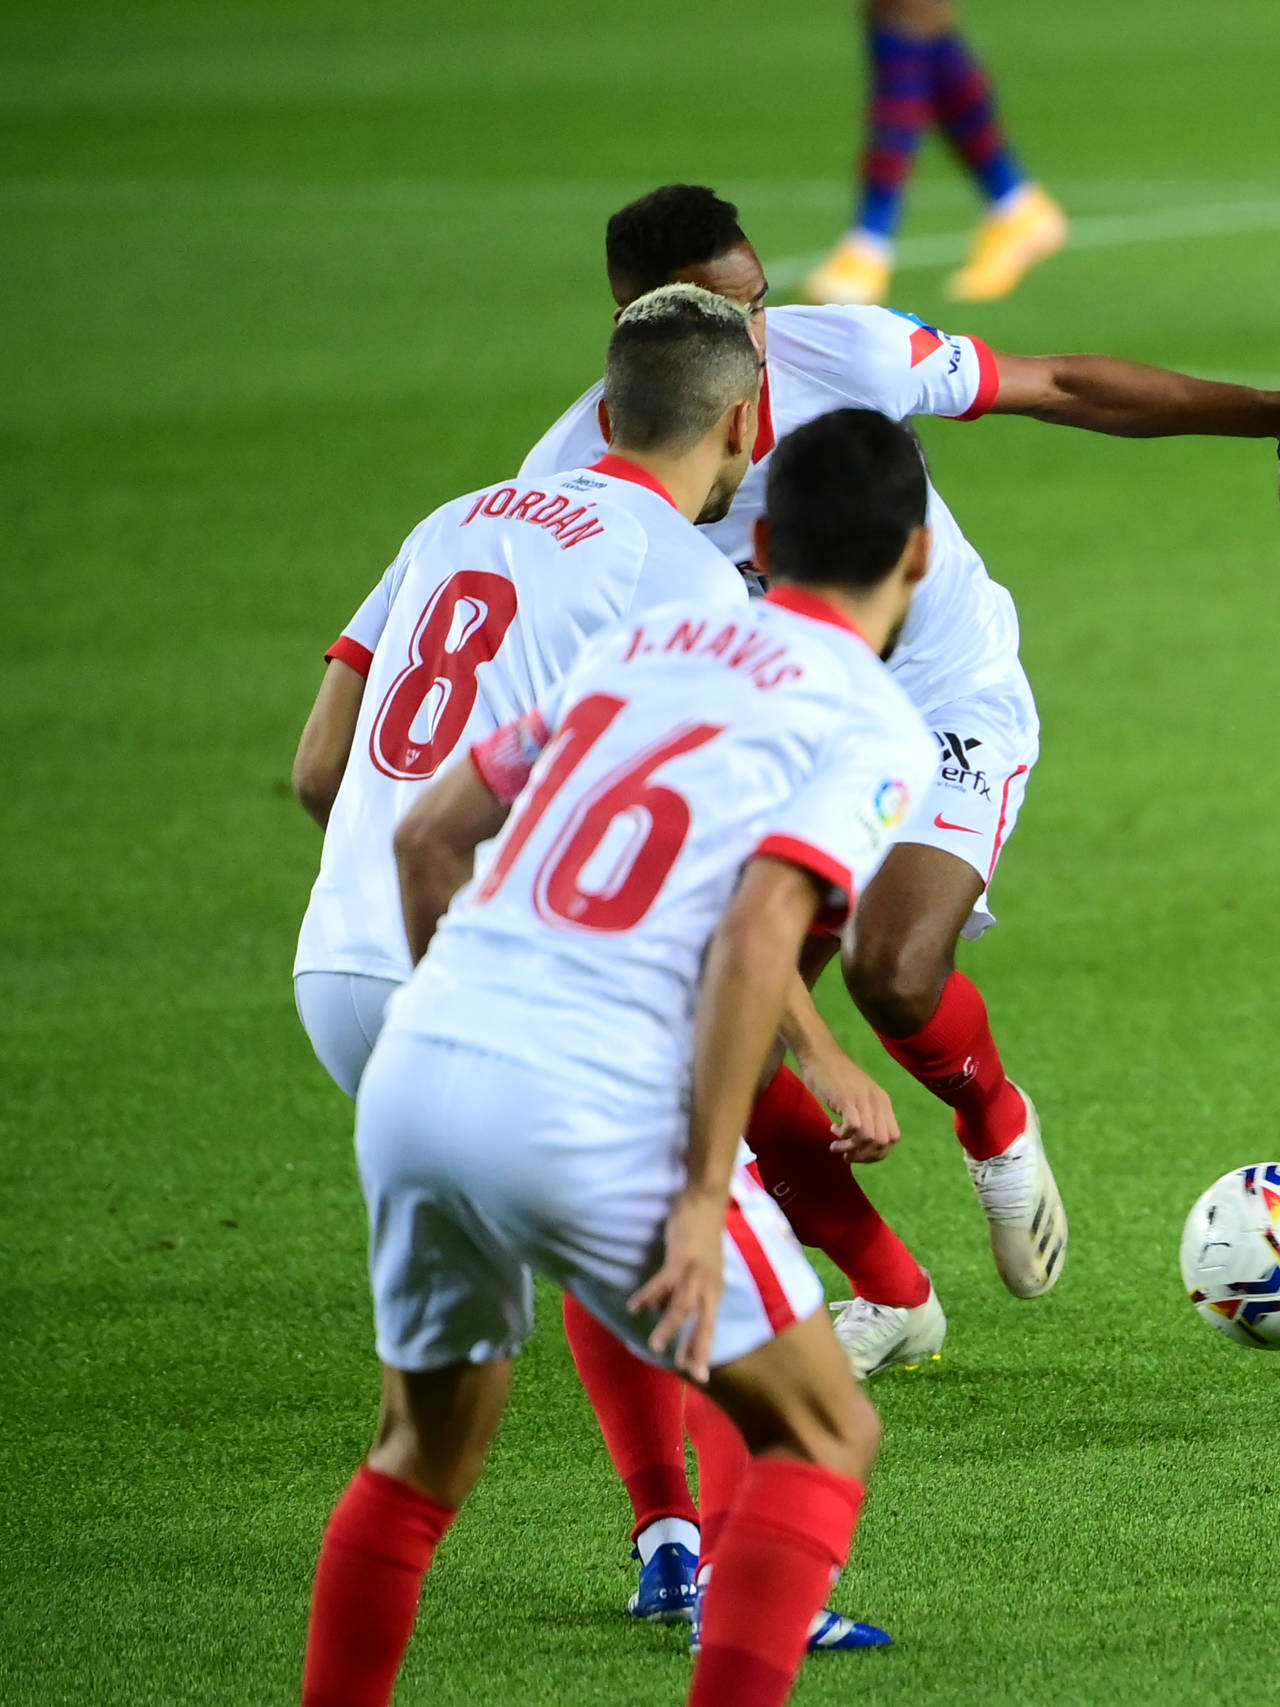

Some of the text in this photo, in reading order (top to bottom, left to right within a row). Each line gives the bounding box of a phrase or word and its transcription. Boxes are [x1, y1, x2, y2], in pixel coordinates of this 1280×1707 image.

[459, 487, 605, 551] JORDÁN
[369, 569, 518, 782] 8
[471, 690, 731, 938] 16
